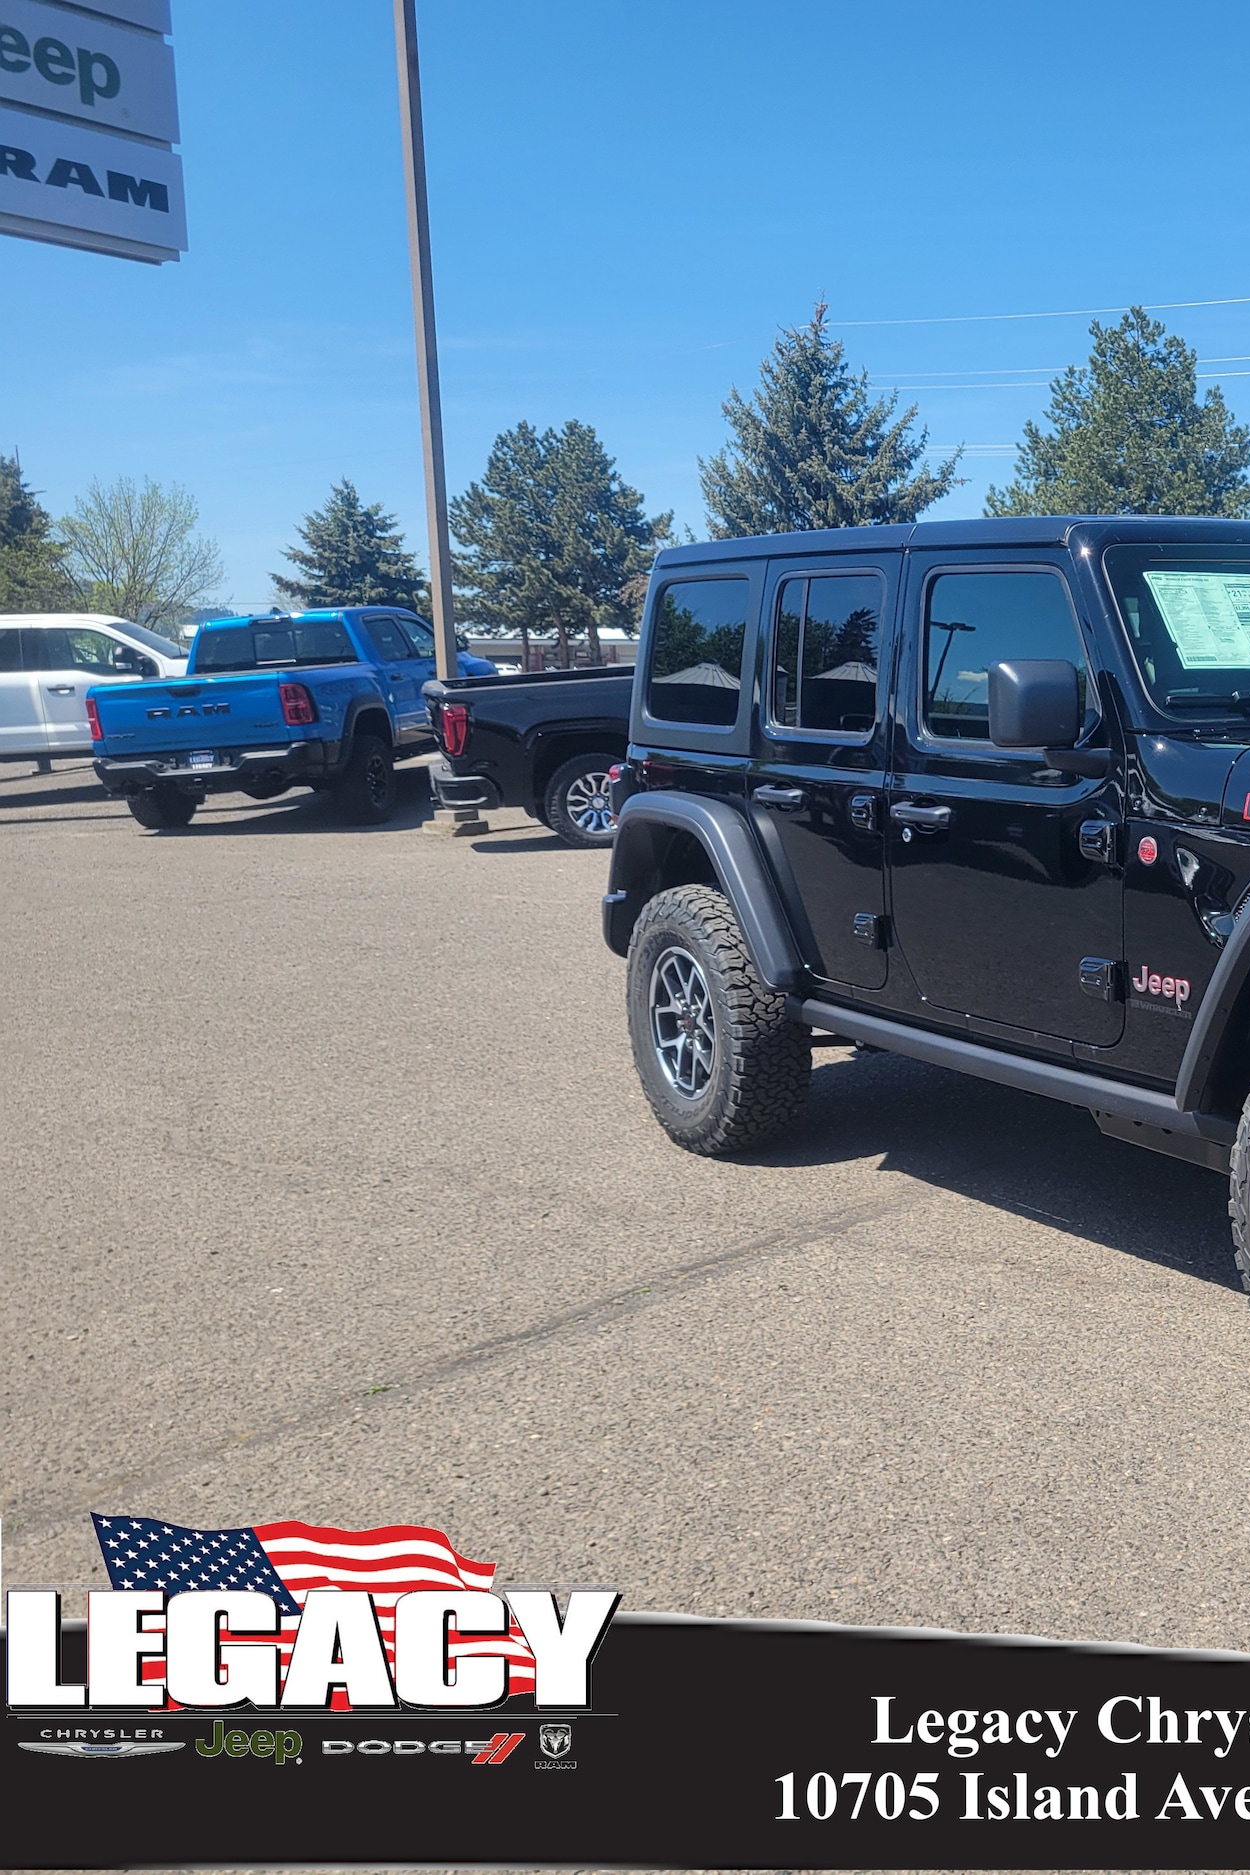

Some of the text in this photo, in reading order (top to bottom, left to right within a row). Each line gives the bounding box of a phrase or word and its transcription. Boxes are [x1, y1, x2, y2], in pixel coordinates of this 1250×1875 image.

[0, 24, 121, 107] eep
[0, 144, 170, 213] RAM
[146, 703, 231, 719] RAM
[1132, 964, 1191, 1010] Jeep
